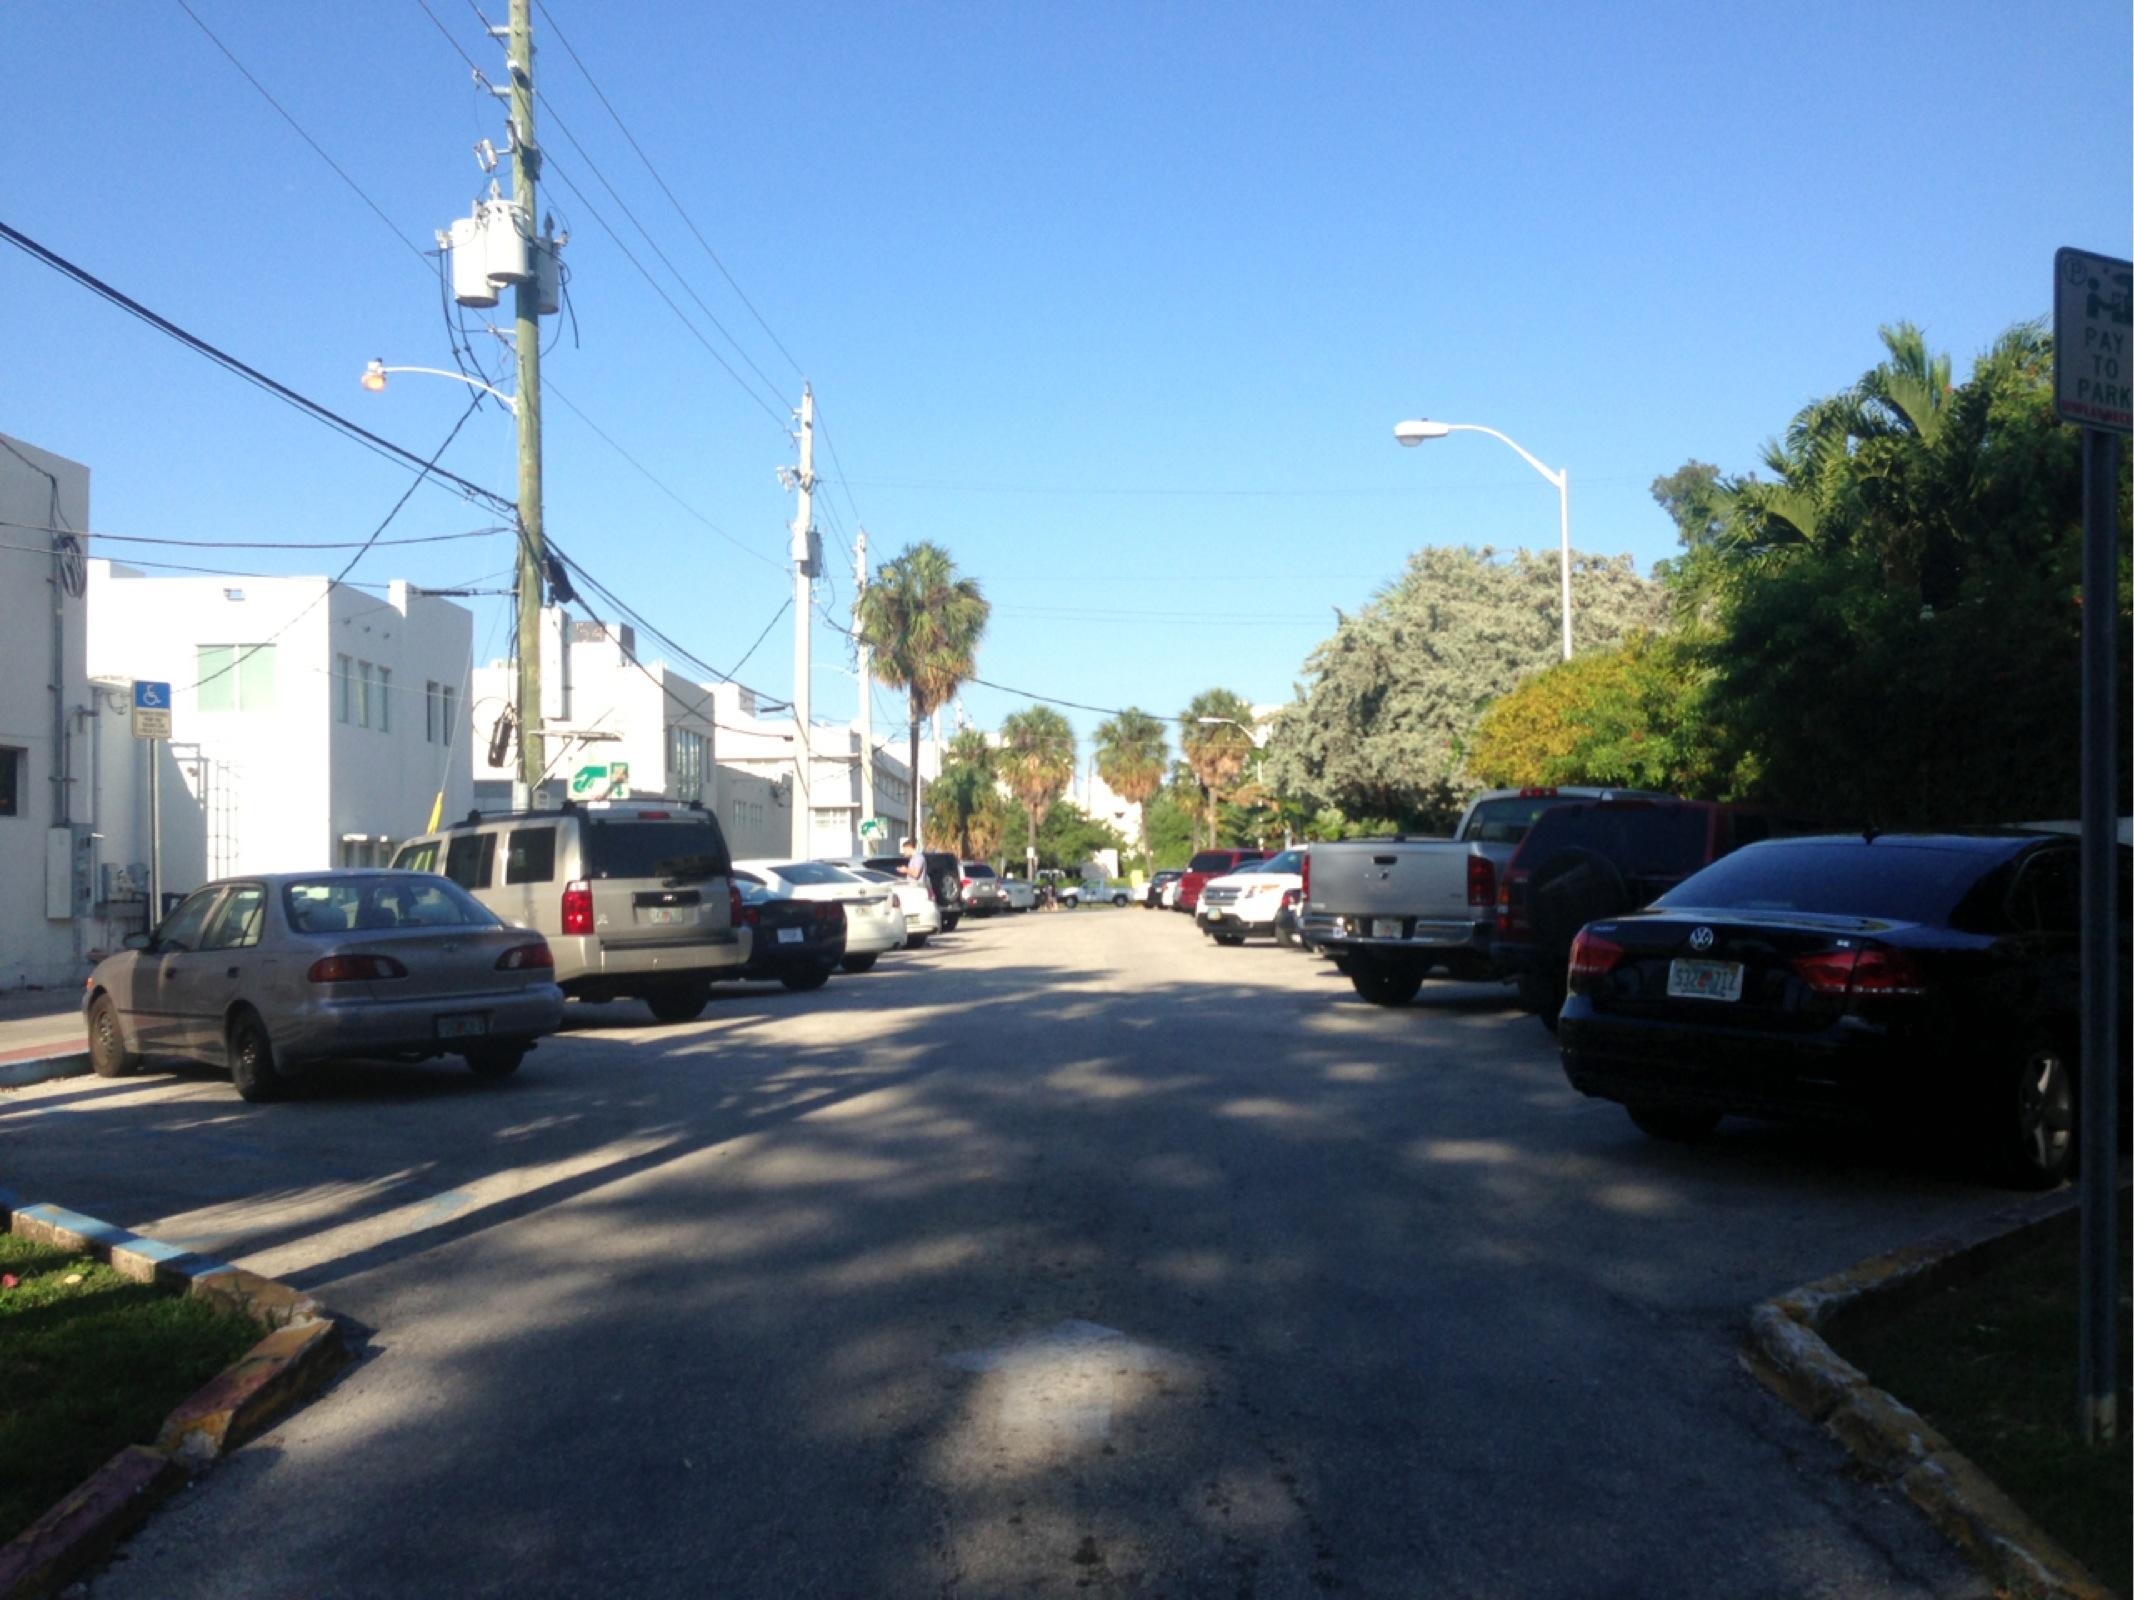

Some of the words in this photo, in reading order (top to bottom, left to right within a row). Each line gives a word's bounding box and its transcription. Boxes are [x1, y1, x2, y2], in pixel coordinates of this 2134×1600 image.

[2085, 327, 2125, 354] PAY
[2093, 355, 2119, 379] TO
[2077, 378, 2131, 409] PARK
